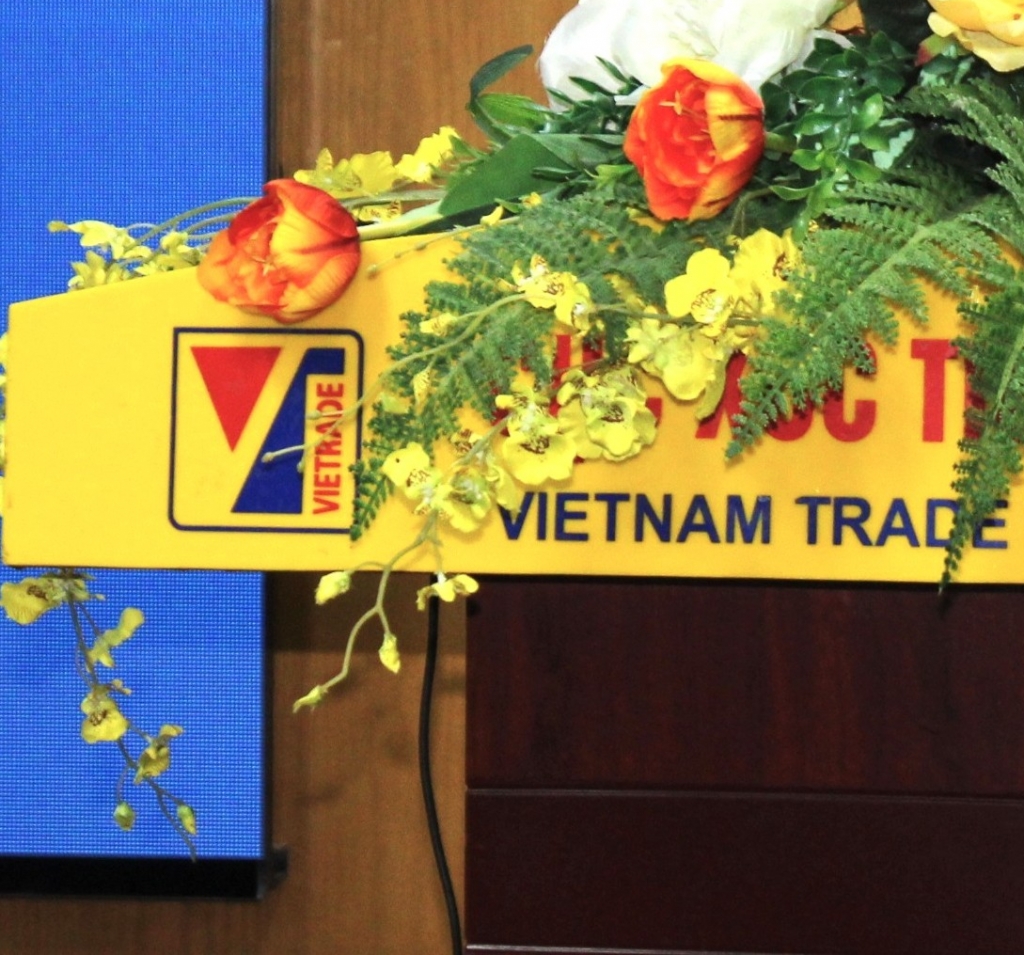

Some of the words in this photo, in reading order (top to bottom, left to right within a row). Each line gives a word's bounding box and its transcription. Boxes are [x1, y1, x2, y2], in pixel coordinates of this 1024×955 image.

[312, 382, 344, 515] VIETRADE
[497, 491, 772, 544] VIETNAM
[795, 496, 1009, 549] TRADE
